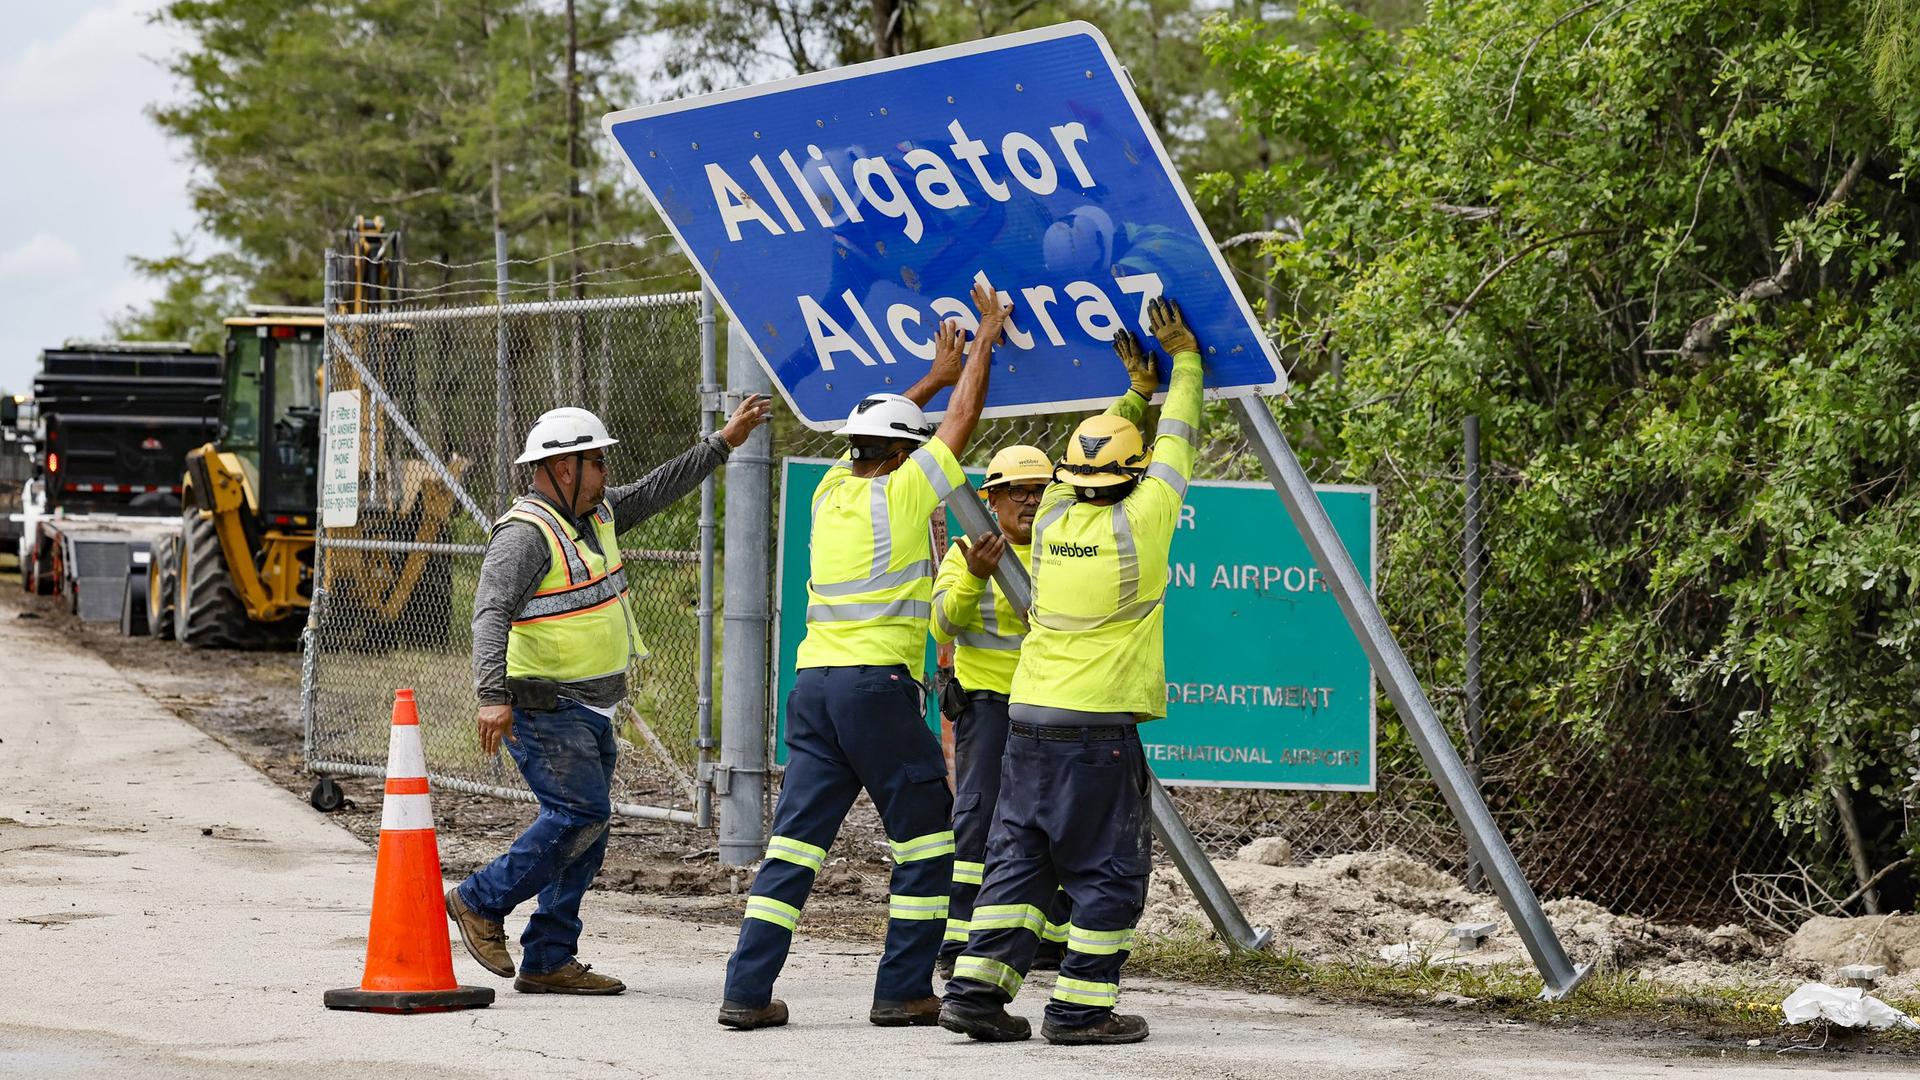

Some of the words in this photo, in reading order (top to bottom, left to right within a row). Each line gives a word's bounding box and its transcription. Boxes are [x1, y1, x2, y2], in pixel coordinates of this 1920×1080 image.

[703, 118, 1096, 244] Alligator
[797, 269, 1164, 371] Alcatraz
[329, 425, 336, 435] NO
[337, 423, 356, 434] ANSWER
[337, 438, 354, 449] OFFICE
[333, 453, 349, 464] PHONE
[335, 469, 347, 479] CALL
[325, 484, 336, 495] CELL
[337, 482, 357, 494] NUMBER
[1049, 542, 1099, 557] webber
[1211, 564, 1328, 593] AIRPOR
[1165, 682, 1335, 709] DEPARTMENT
[1143, 743, 1273, 764] TERNATIONAL
[1280, 748, 1361, 767] AIRPORT
